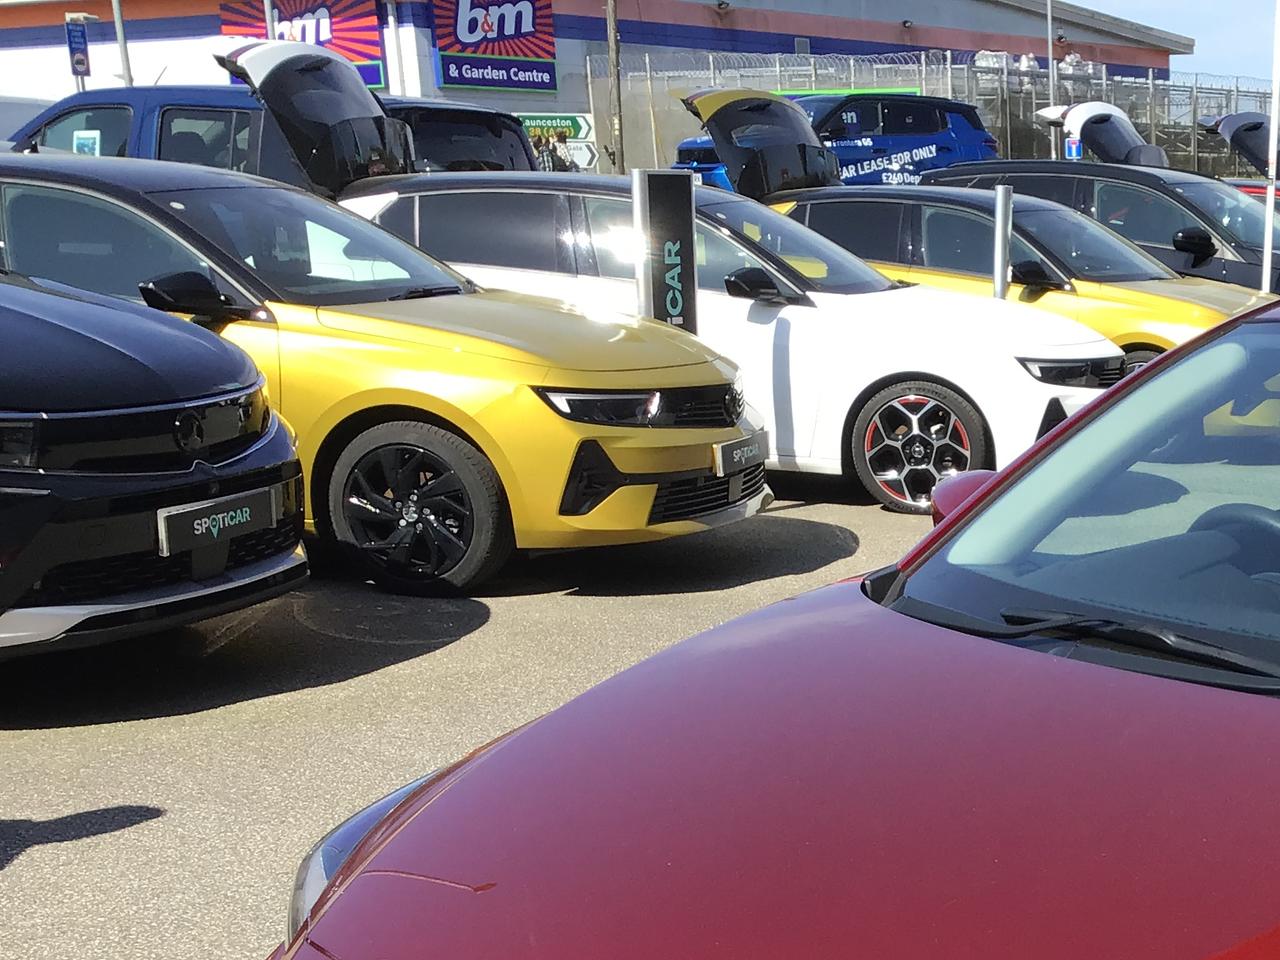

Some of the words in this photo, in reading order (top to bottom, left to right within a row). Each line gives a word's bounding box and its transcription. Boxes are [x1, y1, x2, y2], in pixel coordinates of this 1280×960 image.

[457, 0, 535, 43] b&m
[449, 63, 459, 78] &
[461, 64, 508, 81] Garden
[509, 67, 551, 83] Centre
[522, 118, 572, 127] aunceston
[857, 156, 890, 175] LEASE
[890, 151, 912, 166] FOR
[912, 144, 937, 161] ONLY
